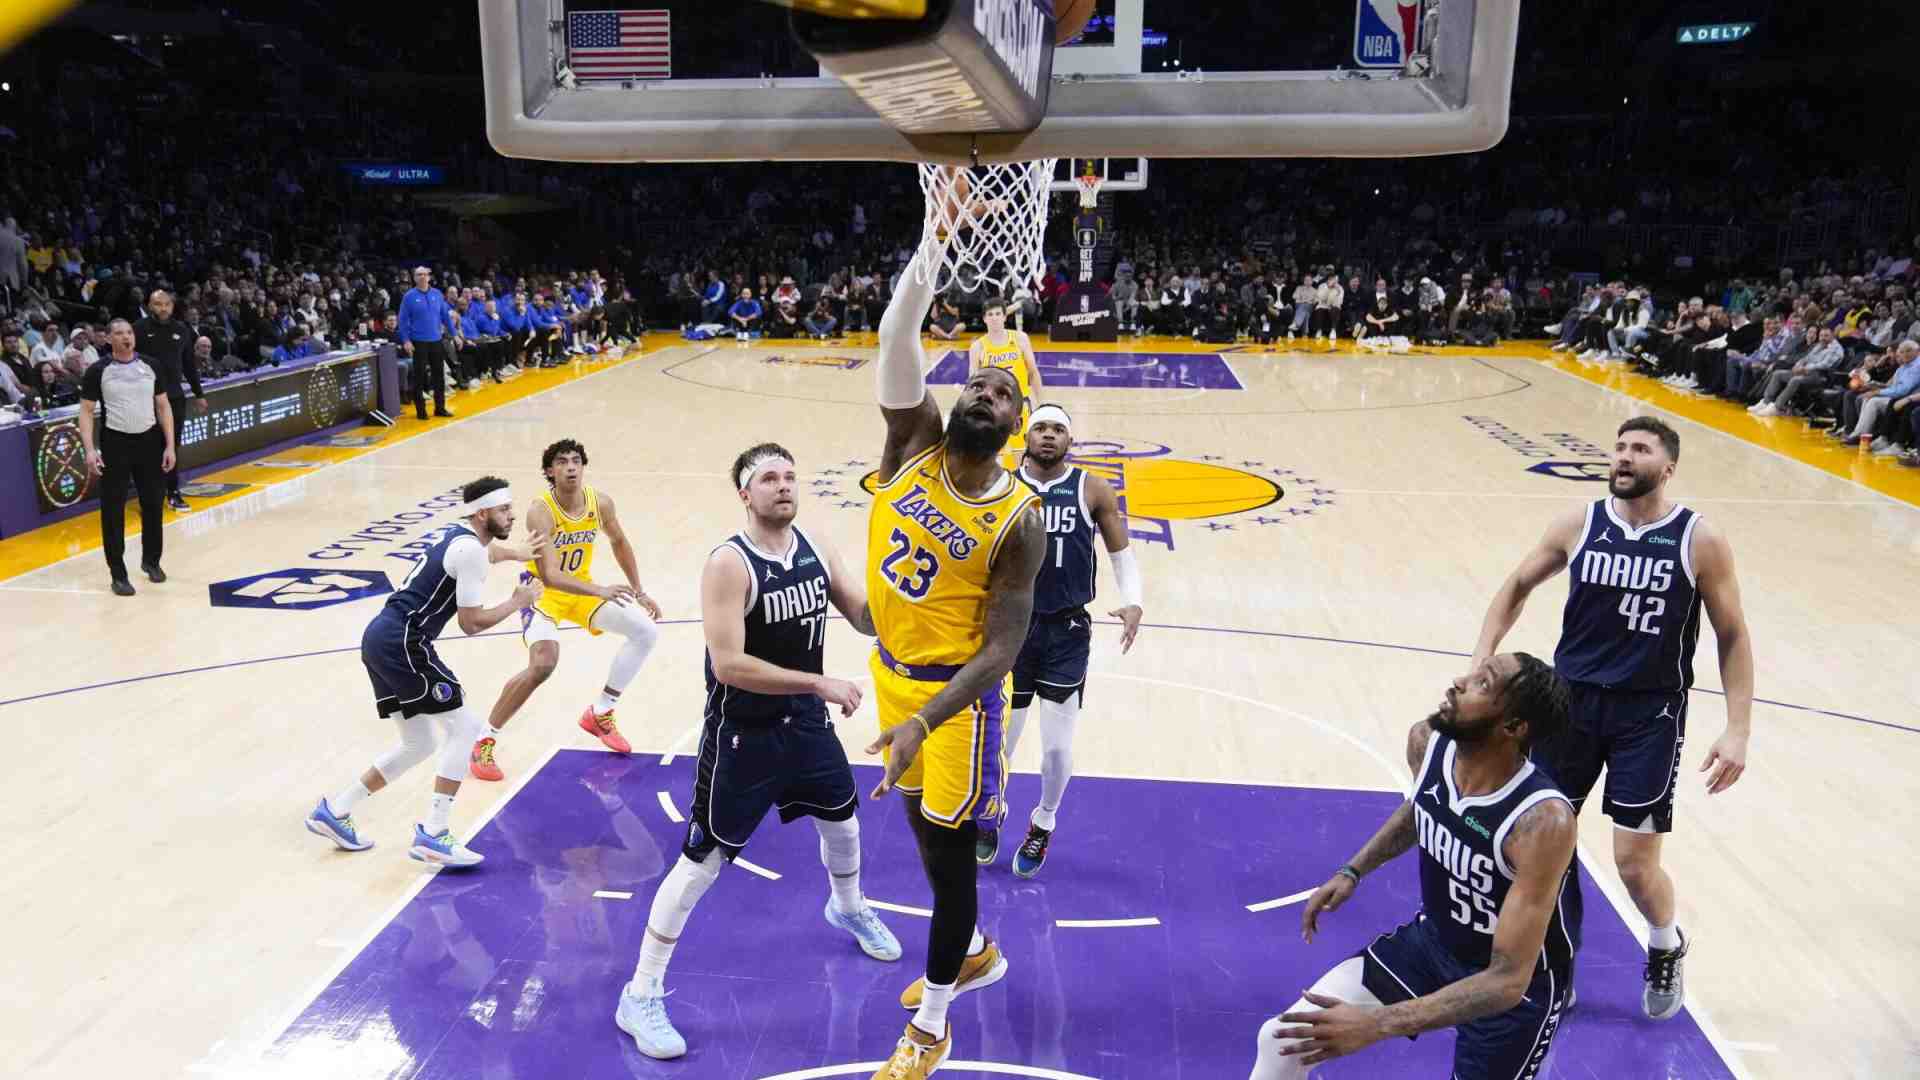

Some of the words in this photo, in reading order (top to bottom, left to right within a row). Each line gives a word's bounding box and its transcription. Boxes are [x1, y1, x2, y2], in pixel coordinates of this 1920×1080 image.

[1363, 35, 1393, 57] NBA
[1697, 26, 1752, 40] DELTA
[399, 169, 430, 179] ULTRA
[1080, 249, 1093, 259] GET
[1080, 260, 1093, 271] THE
[1079, 272, 1093, 282] APP
[212, 407, 241, 437] 7:30
[242, 404, 255, 429] ET
[260, 393, 300, 424] ESPN
[891, 484, 978, 560] LAKERS
[553, 529, 597, 549] LAKERS
[1055, 537, 1064, 568] 1
[1648, 535, 1677, 546] chime
[559, 549, 584, 572] 10
[880, 527, 940, 601] 23
[1581, 550, 1675, 592] MAVS
[763, 575, 827, 625] MAVS
[1618, 592, 1666, 636] 42
[800, 612, 826, 651] 77
[1414, 800, 1495, 895] MAVS
[1448, 877, 1499, 936] 55
